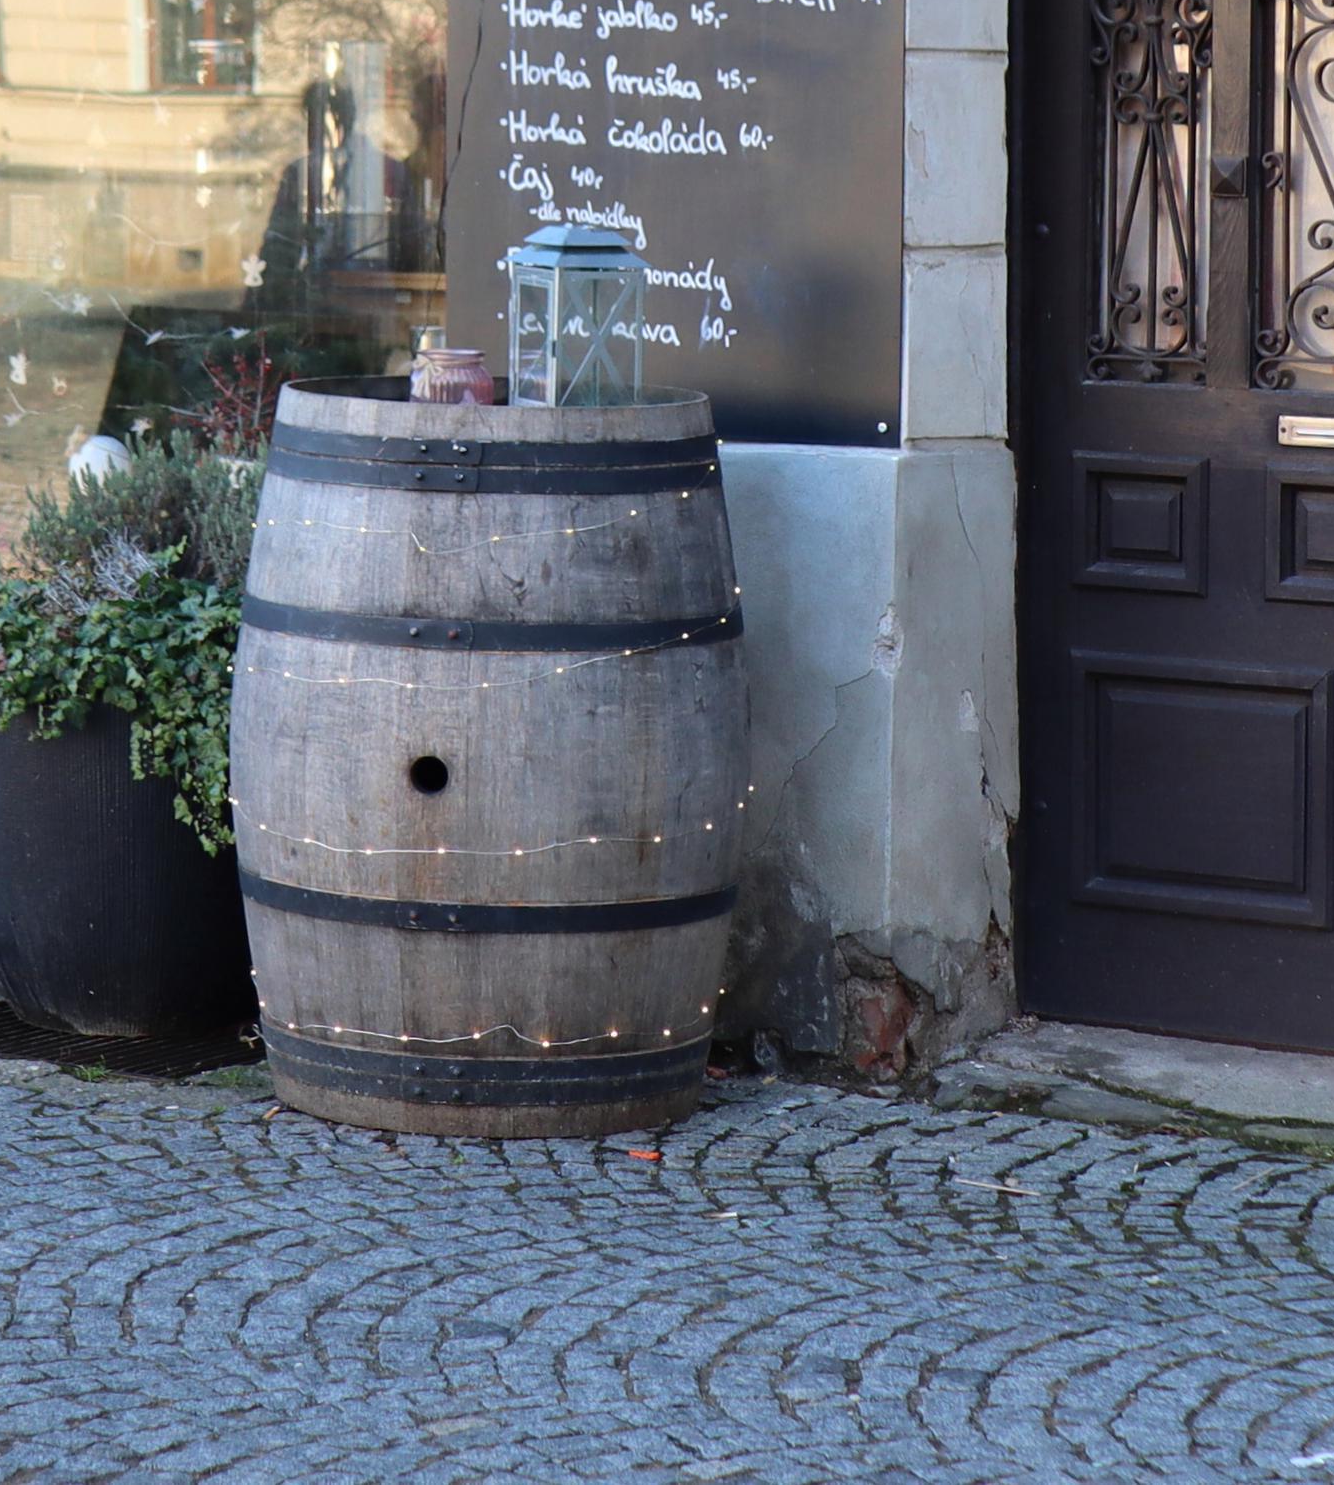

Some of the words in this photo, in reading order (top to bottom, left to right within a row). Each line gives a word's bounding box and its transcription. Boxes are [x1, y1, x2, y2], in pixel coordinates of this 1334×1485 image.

[509, 49, 591, 88] Horká
[605, 54, 702, 101] hruška
[508, 109, 587, 145] Horká
[608, 117, 728, 156] čokoláda
[507, 154, 555, 200] Čaj
